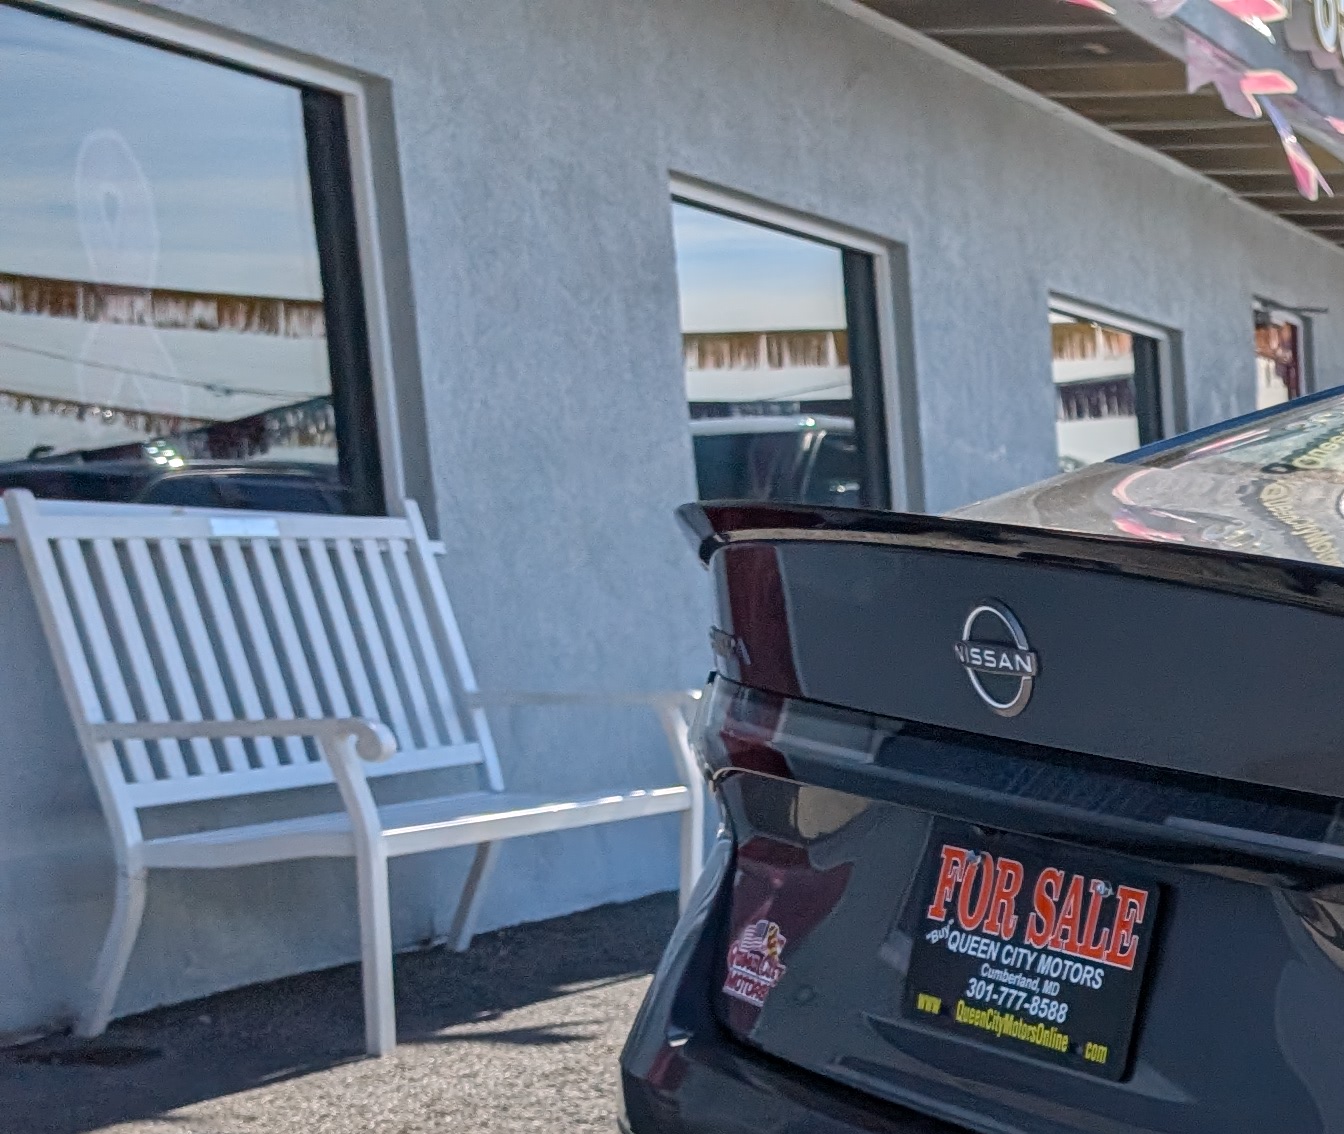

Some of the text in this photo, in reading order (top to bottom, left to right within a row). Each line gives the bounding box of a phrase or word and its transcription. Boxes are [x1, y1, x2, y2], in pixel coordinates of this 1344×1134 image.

[955, 641, 1033, 673] NISSAN
[926, 844, 1149, 973] FOR SALE
[947, 930, 1001, 962] QUEEN
[1001, 944, 1039, 971] CITY
[1036, 953, 1105, 990] MOTORS
[980, 962, 1061, 997] Cumberland, MD
[965, 977, 1069, 1024] 301-777-8588
